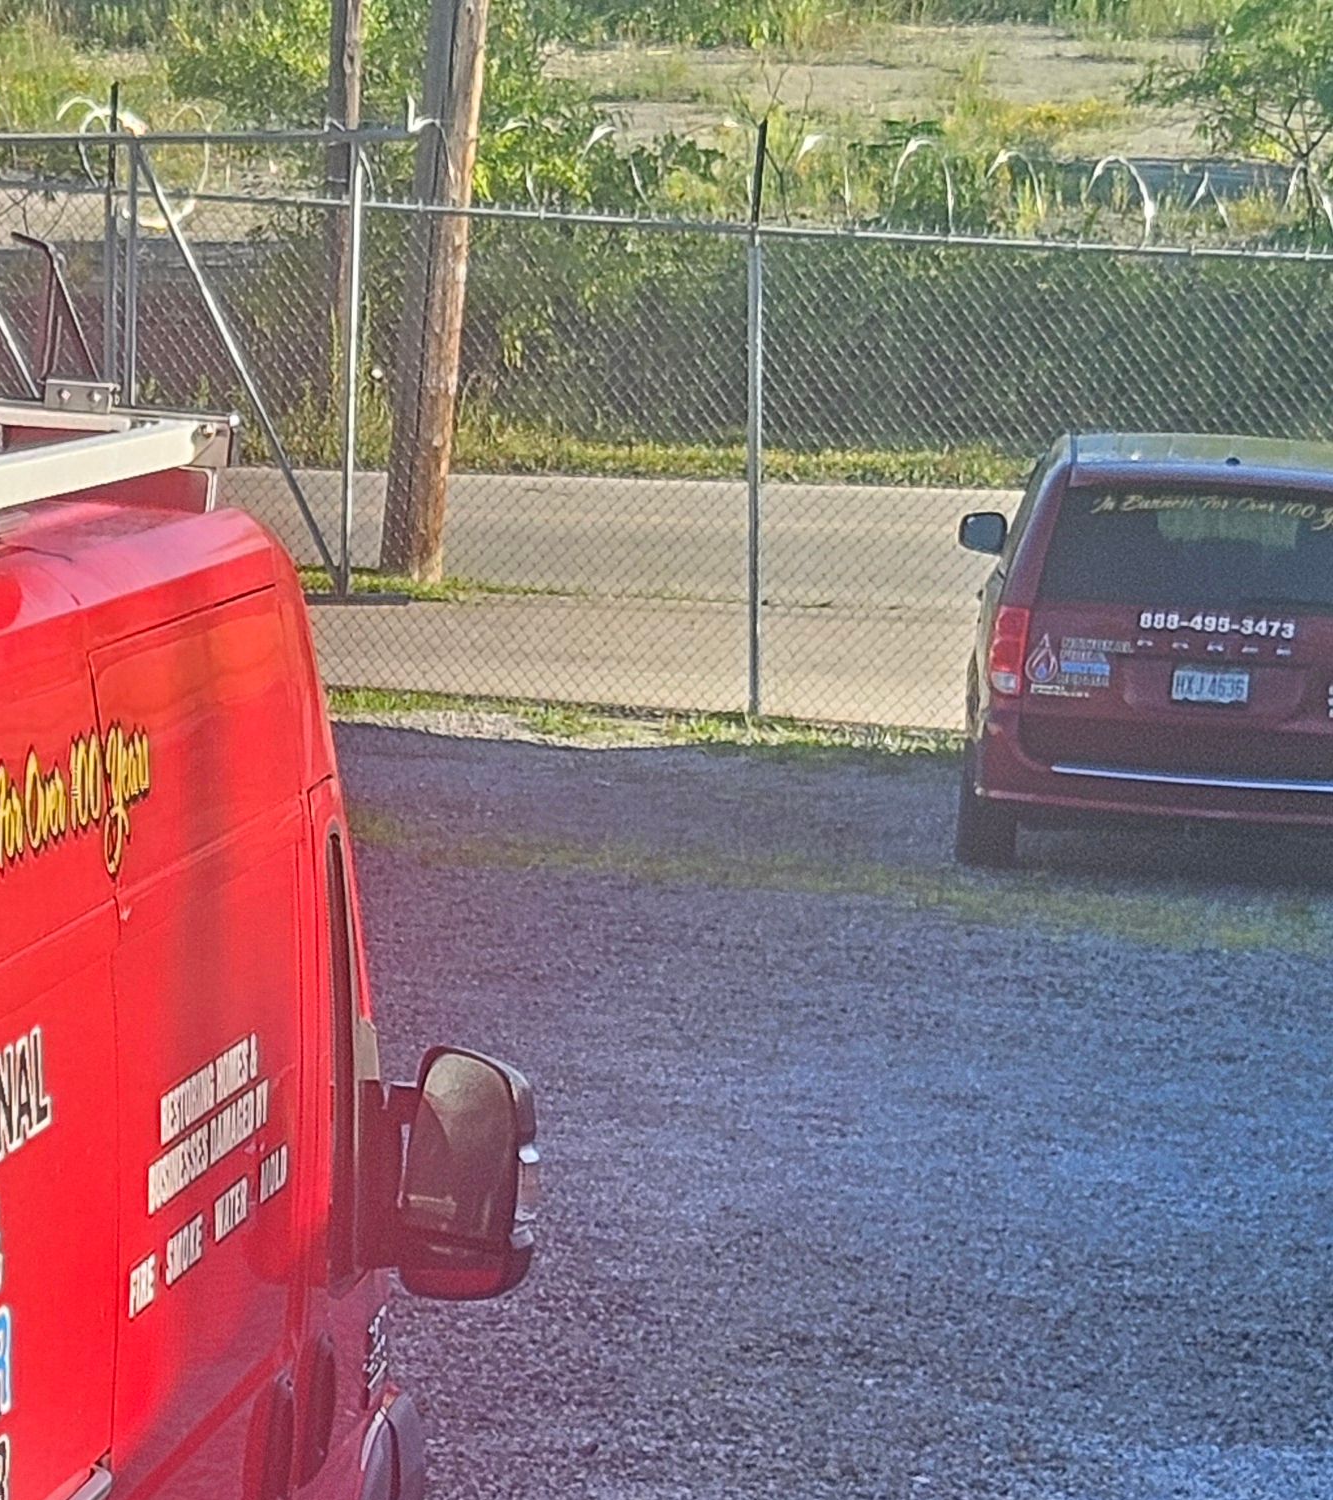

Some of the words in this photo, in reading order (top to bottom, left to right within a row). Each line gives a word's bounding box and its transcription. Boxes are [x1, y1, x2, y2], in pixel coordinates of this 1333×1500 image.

[1281, 502, 1317, 520] 100
[1138, 611, 1296, 640] 888-495-3473
[25, 749, 67, 849] Over
[70, 732, 102, 832] 100
[104, 726, 150, 874] Years
[128, 1251, 156, 1320] FIRE
[165, 1212, 204, 1286] SMOKE
[214, 1176, 248, 1243] WATER
[259, 1143, 288, 1204] MOLD
